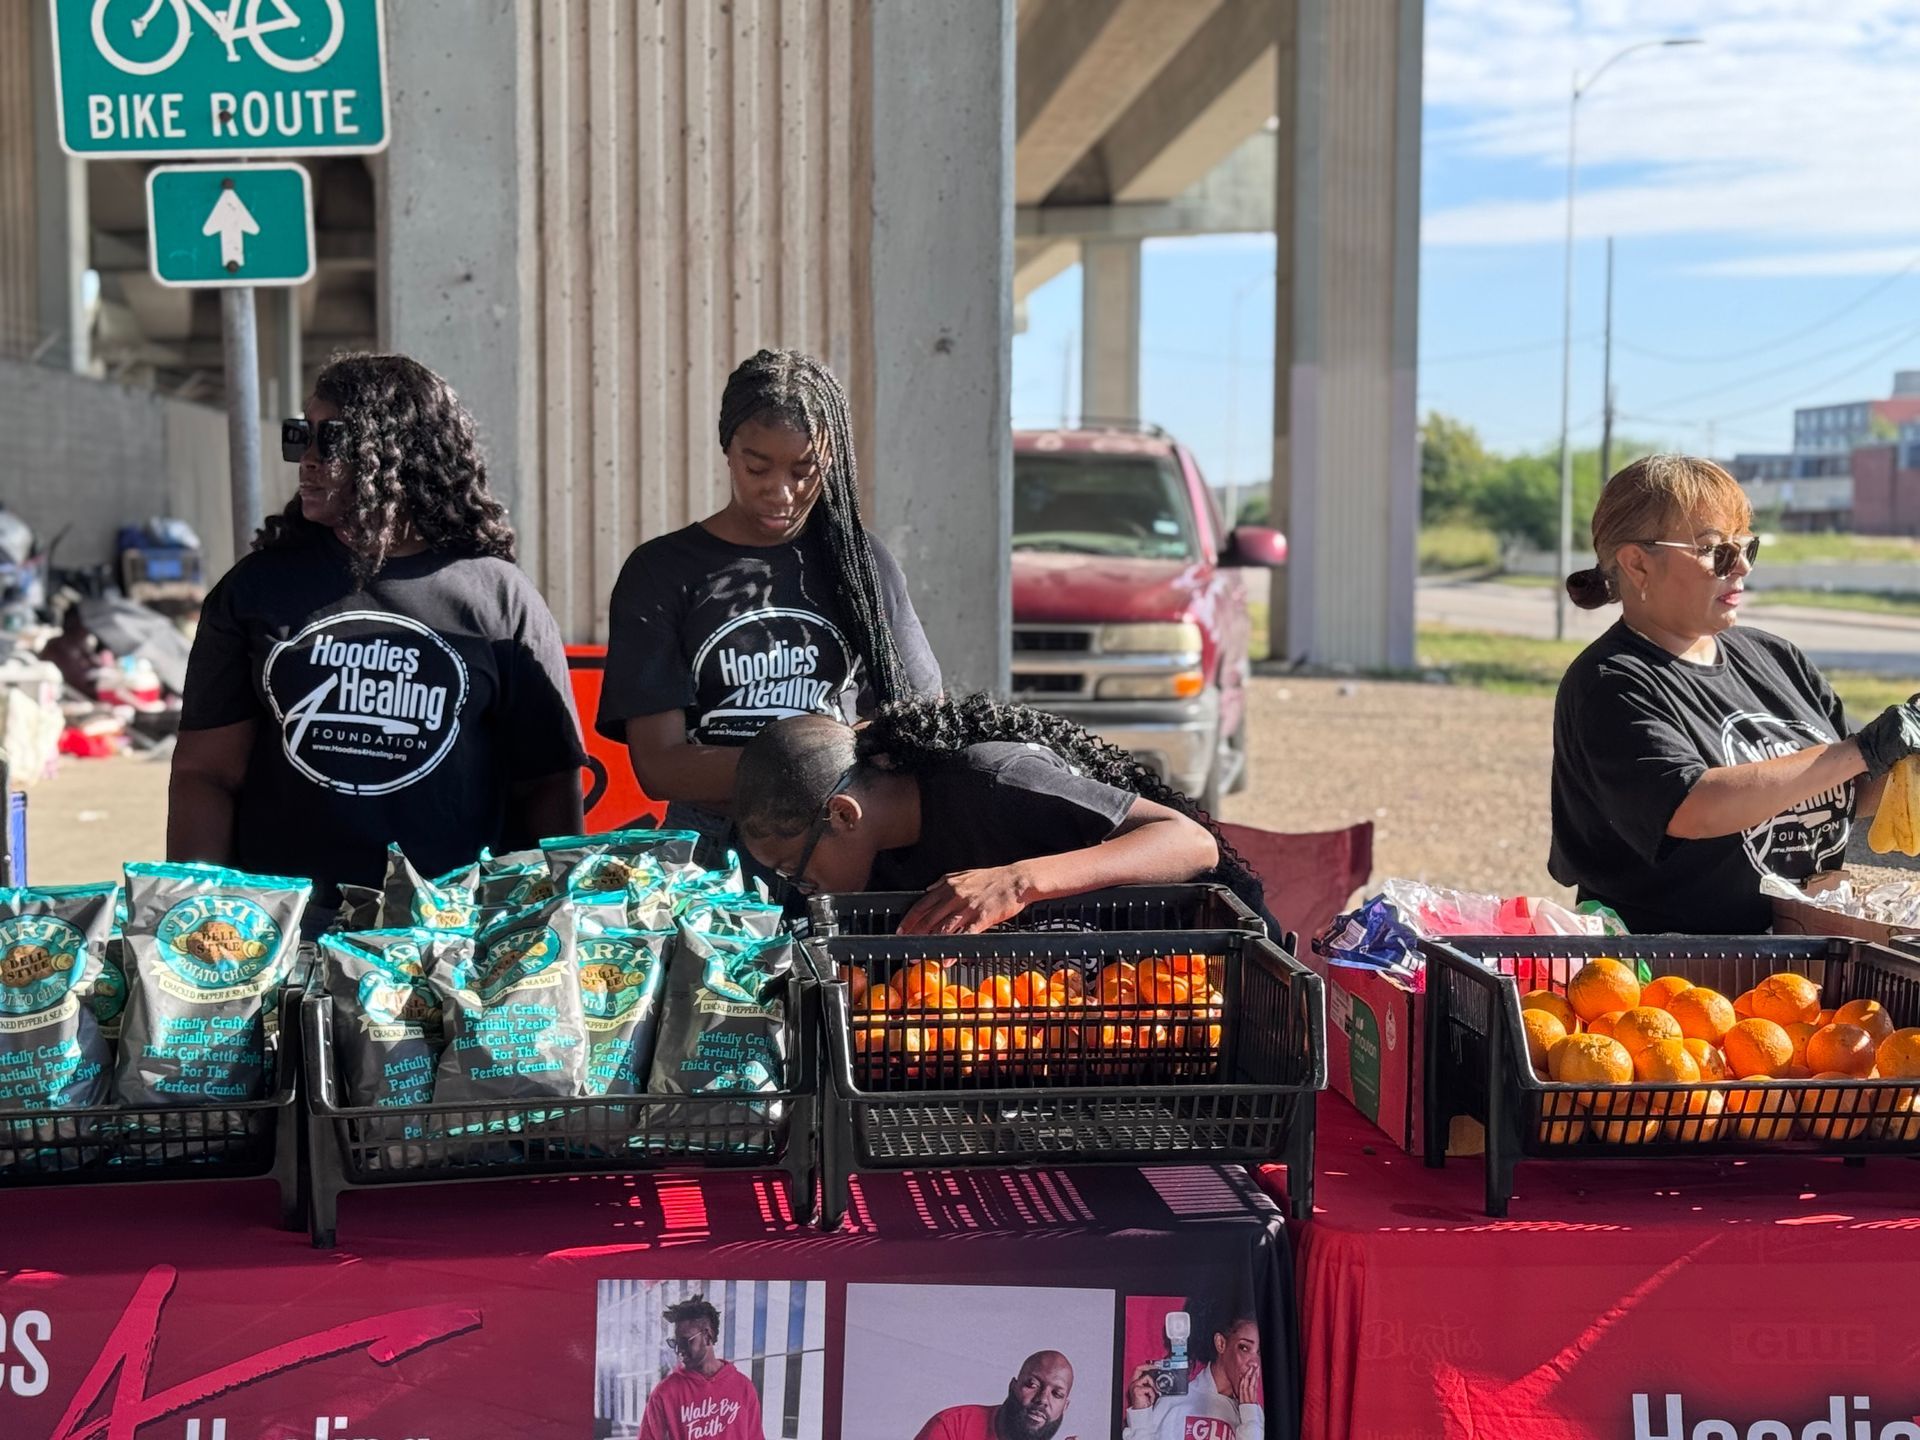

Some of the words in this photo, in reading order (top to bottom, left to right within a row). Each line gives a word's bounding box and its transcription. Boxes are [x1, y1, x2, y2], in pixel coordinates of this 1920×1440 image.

[88, 94, 187, 140] BIKE
[211, 89, 360, 137] ROUTE
[310, 634, 421, 674] Hoodies
[719, 639, 819, 687] Hoodies
[338, 666, 447, 731] Healing
[282, 672, 420, 759] 4
[312, 727, 428, 750] FOUNDATION
[7, 960, 50, 981] STYLE
[175, 956, 219, 984] POTATO
[221, 961, 258, 983] CHIPS
[540, 975, 556, 984] SALT
[732, 1005, 759, 1015] PEPPER
[160, 1015, 208, 1032] Artfully
[465, 1019, 515, 1034] Partially
[160, 1031, 212, 1047] Partially
[453, 1034, 483, 1051] Thick
[485, 1033, 508, 1047] Cut
[547, 1032, 577, 1049] Style
[696, 1031, 742, 1047] Artfully
[142, 1044, 176, 1059] Thick
[178, 1046, 200, 1061] Cut
[202, 1048, 239, 1063] Kettle
[491, 1048, 514, 1061] For
[515, 1046, 540, 1058] The
[696, 1045, 744, 1061] Partially
[0, 1066, 42, 1082] artially
[180, 1063, 204, 1078] For
[206, 1064, 230, 1078] The
[384, 1055, 432, 1077] Artfully
[470, 1064, 515, 1081] Perfect
[516, 1059, 565, 1074] Crunch!
[587, 1065, 617, 1079] ettle
[681, 1059, 710, 1072] Thick
[155, 1080, 201, 1095] Perfect
[389, 1070, 436, 1092] Partiall
[715, 1075, 737, 1089] For
[24, 1098, 45, 1110] For
[681, 1396, 720, 1423] Walk
[720, 1397, 741, 1425] By
[686, 1415, 726, 1440] Faith
